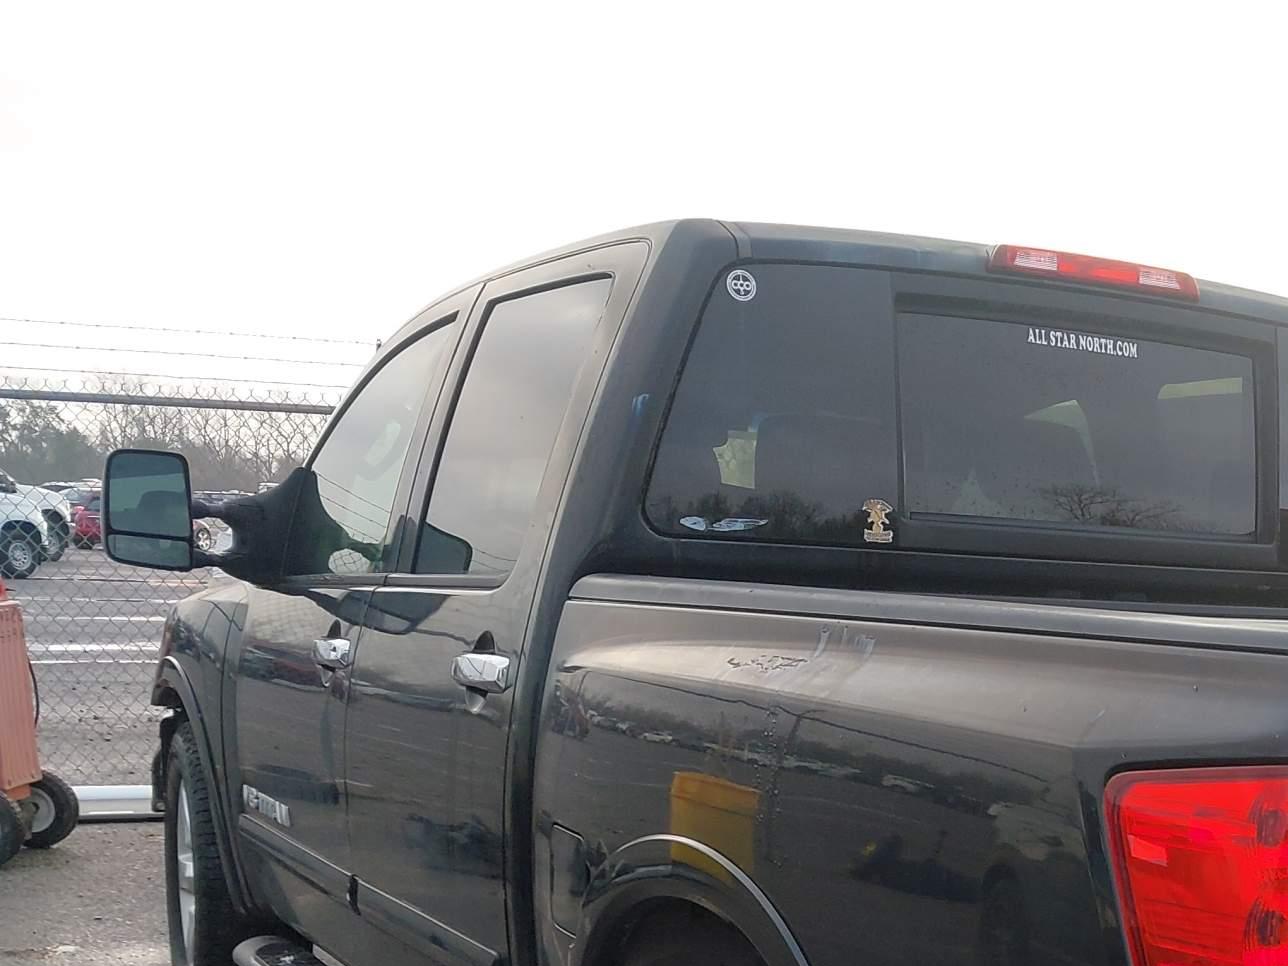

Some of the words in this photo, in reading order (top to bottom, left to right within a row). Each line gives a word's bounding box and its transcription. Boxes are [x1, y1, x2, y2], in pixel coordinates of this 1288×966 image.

[1027, 327, 1048, 345] ALL
[1049, 330, 1078, 350] STAR
[1078, 334, 1138, 359] NORTH.COM
